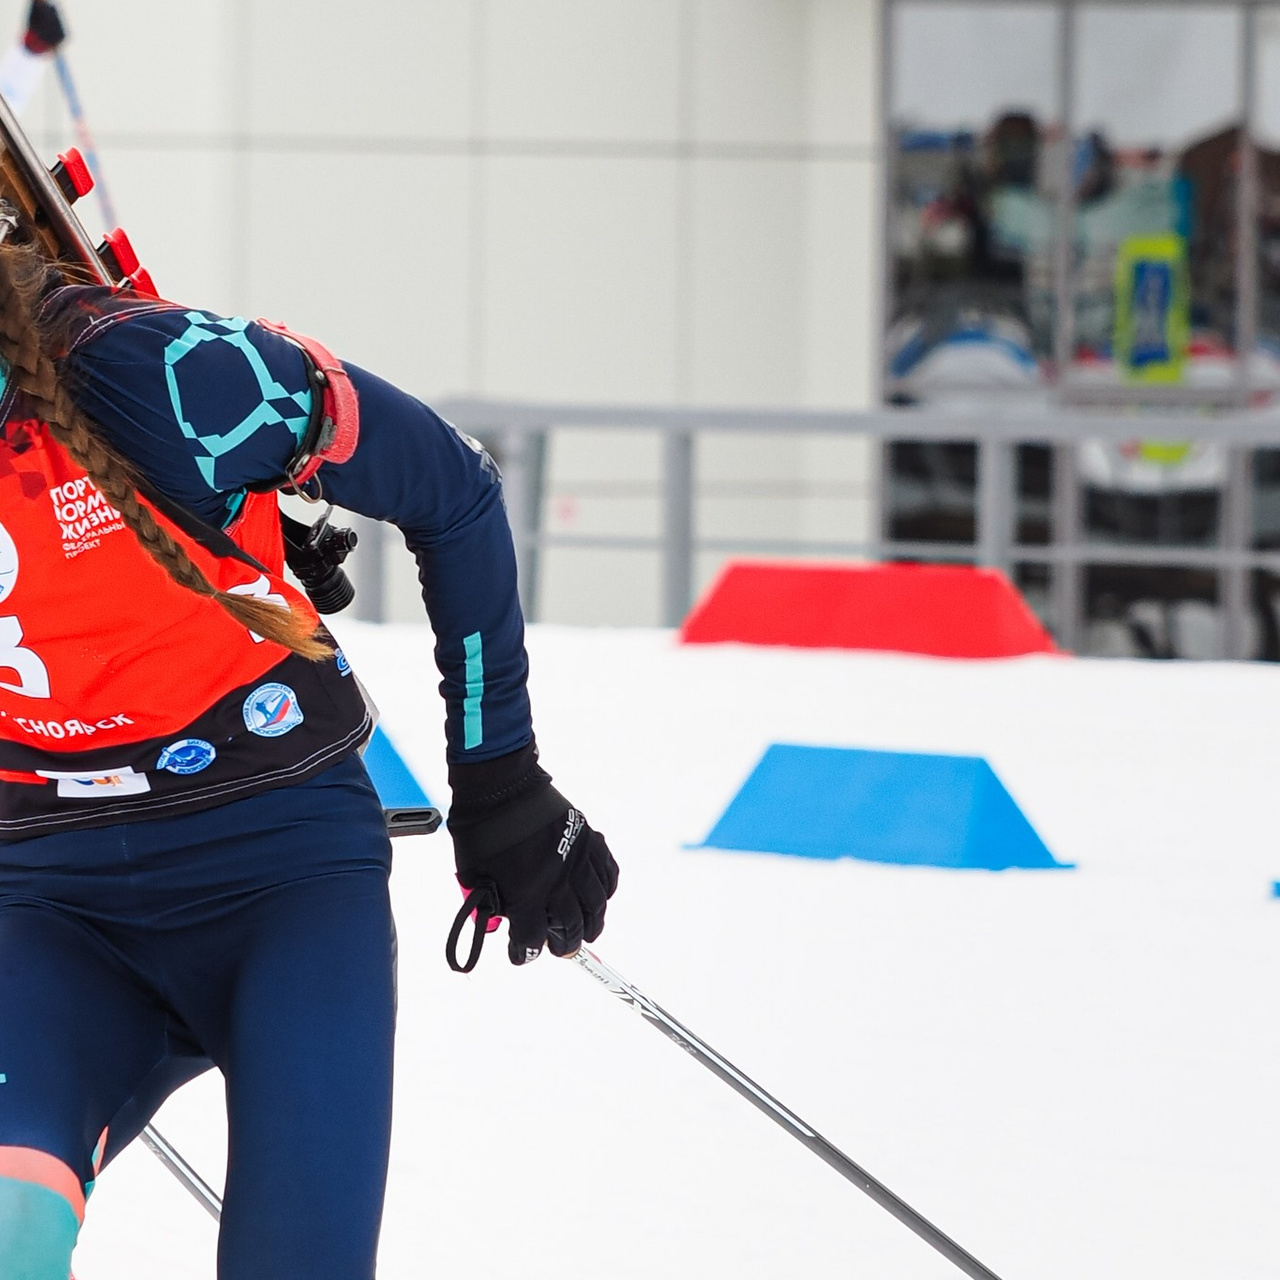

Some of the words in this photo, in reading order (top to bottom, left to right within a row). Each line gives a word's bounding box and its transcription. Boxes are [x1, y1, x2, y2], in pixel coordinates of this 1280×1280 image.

[49, 476, 96, 506] ПОРТ
[53, 490, 107, 523] ОРМ
[62, 521, 126, 551] ФЕДЕРАЛЬНЫ
